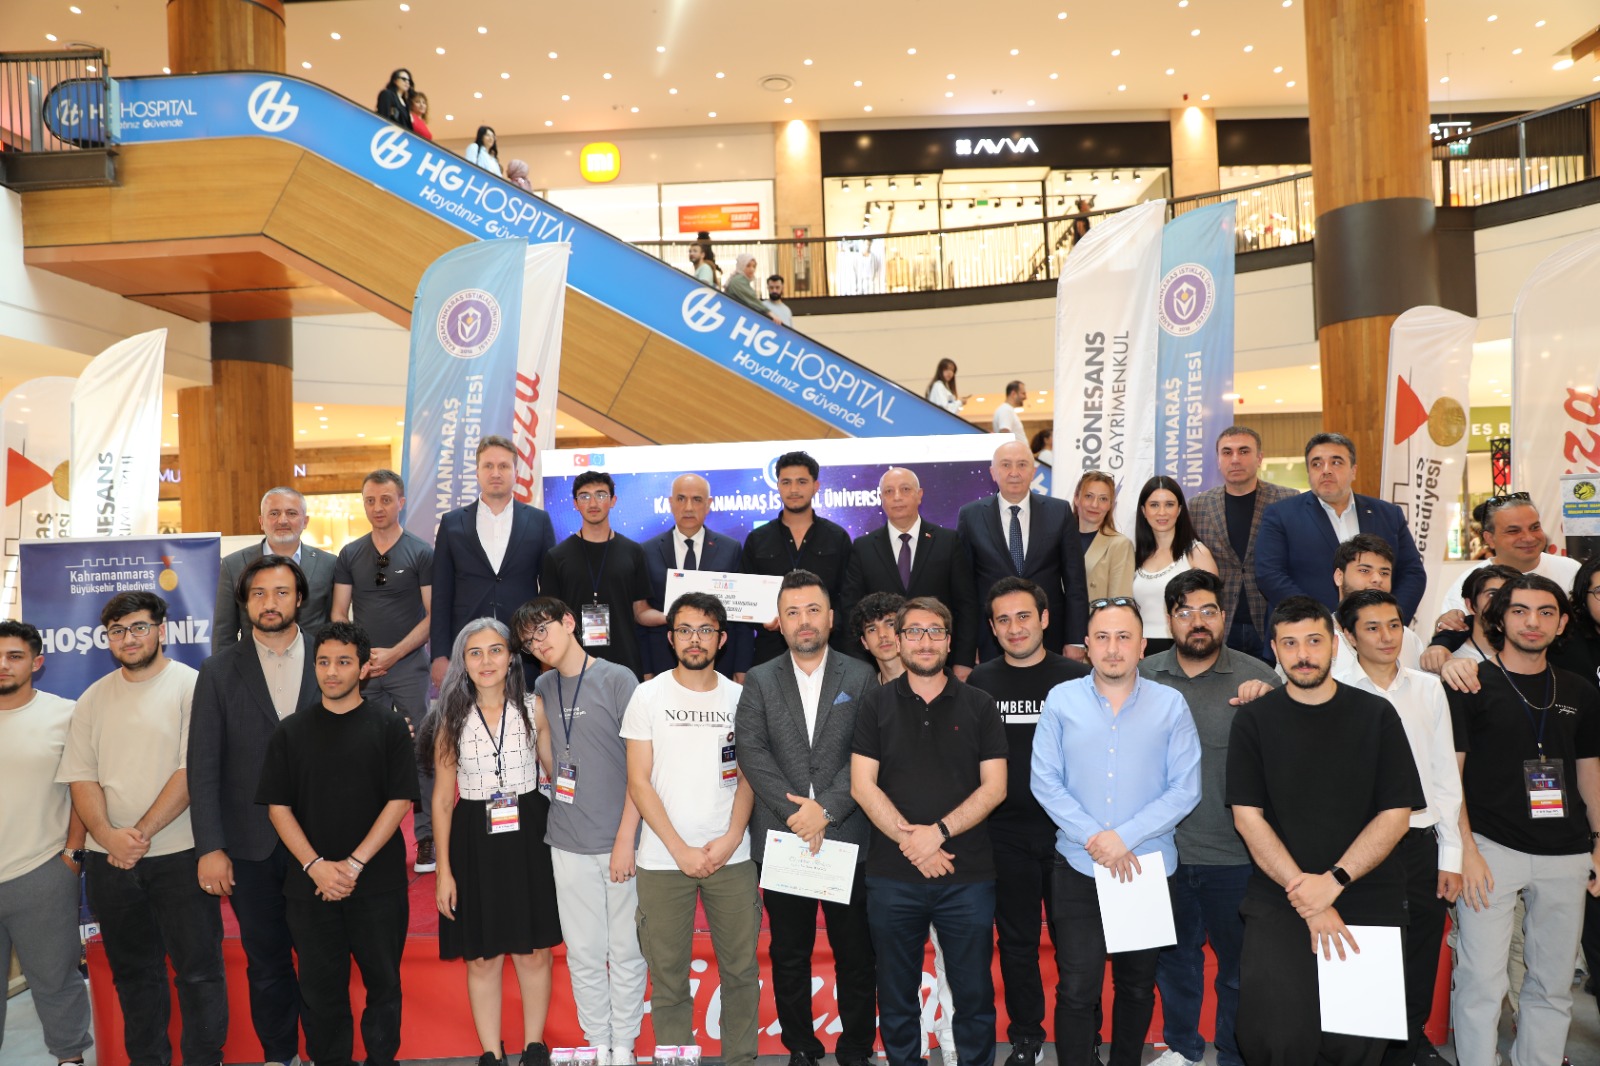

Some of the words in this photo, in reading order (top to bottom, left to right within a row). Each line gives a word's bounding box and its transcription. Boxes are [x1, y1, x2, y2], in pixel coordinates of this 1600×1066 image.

[120, 99, 198, 118] HOSPITAL
[973, 137, 1039, 154] AVVA
[416, 152, 465, 191] HG
[419, 185, 484, 226] Hayatınız
[729, 316, 779, 357] HG
[776, 340, 896, 425] HOSPITAL
[732, 350, 800, 394] Hayatınız
[802, 387, 866, 429] Güvende
[1108, 330, 1130, 470] GAYRİMENKUL
[1181, 350, 1202, 488] ÜNİVERSİTESİ
[1165, 376, 1183, 480] ANMARAŞ
[825, 486, 882, 508] ÜNİVERSİ
[69, 568, 155, 583] Kahramanmaraş
[70, 582, 114, 595] Büyükşehir
[116, 580, 156, 593] Belediyesi
[38, 615, 210, 656] HOŞGİNİZ
